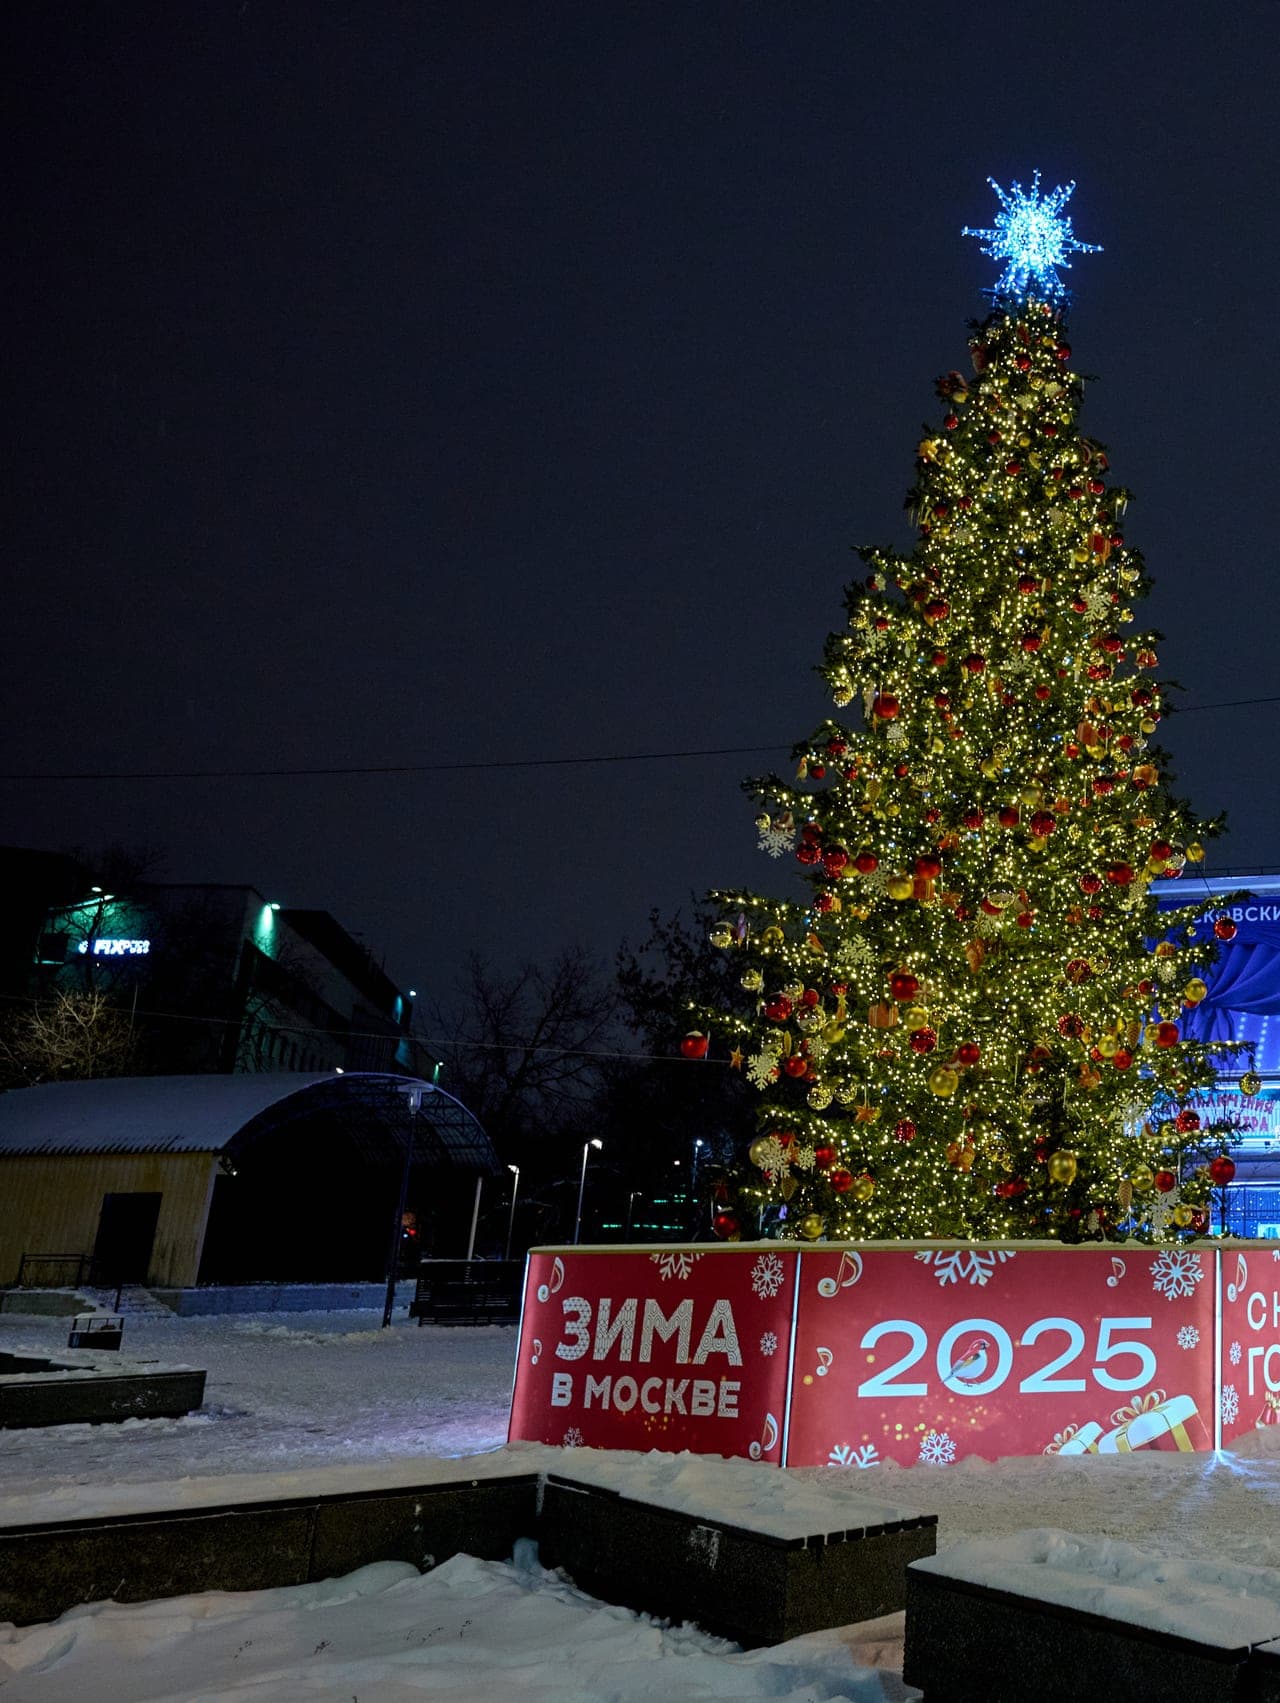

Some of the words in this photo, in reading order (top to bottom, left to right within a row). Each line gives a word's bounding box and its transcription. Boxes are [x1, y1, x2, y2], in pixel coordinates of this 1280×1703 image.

[555, 1297, 743, 1366] ЗИМА
[1247, 1292, 1267, 1330] С
[858, 1317, 1157, 1397] 2025
[551, 1372, 573, 1407] В
[583, 1374, 741, 1418] МОСКВЕ
